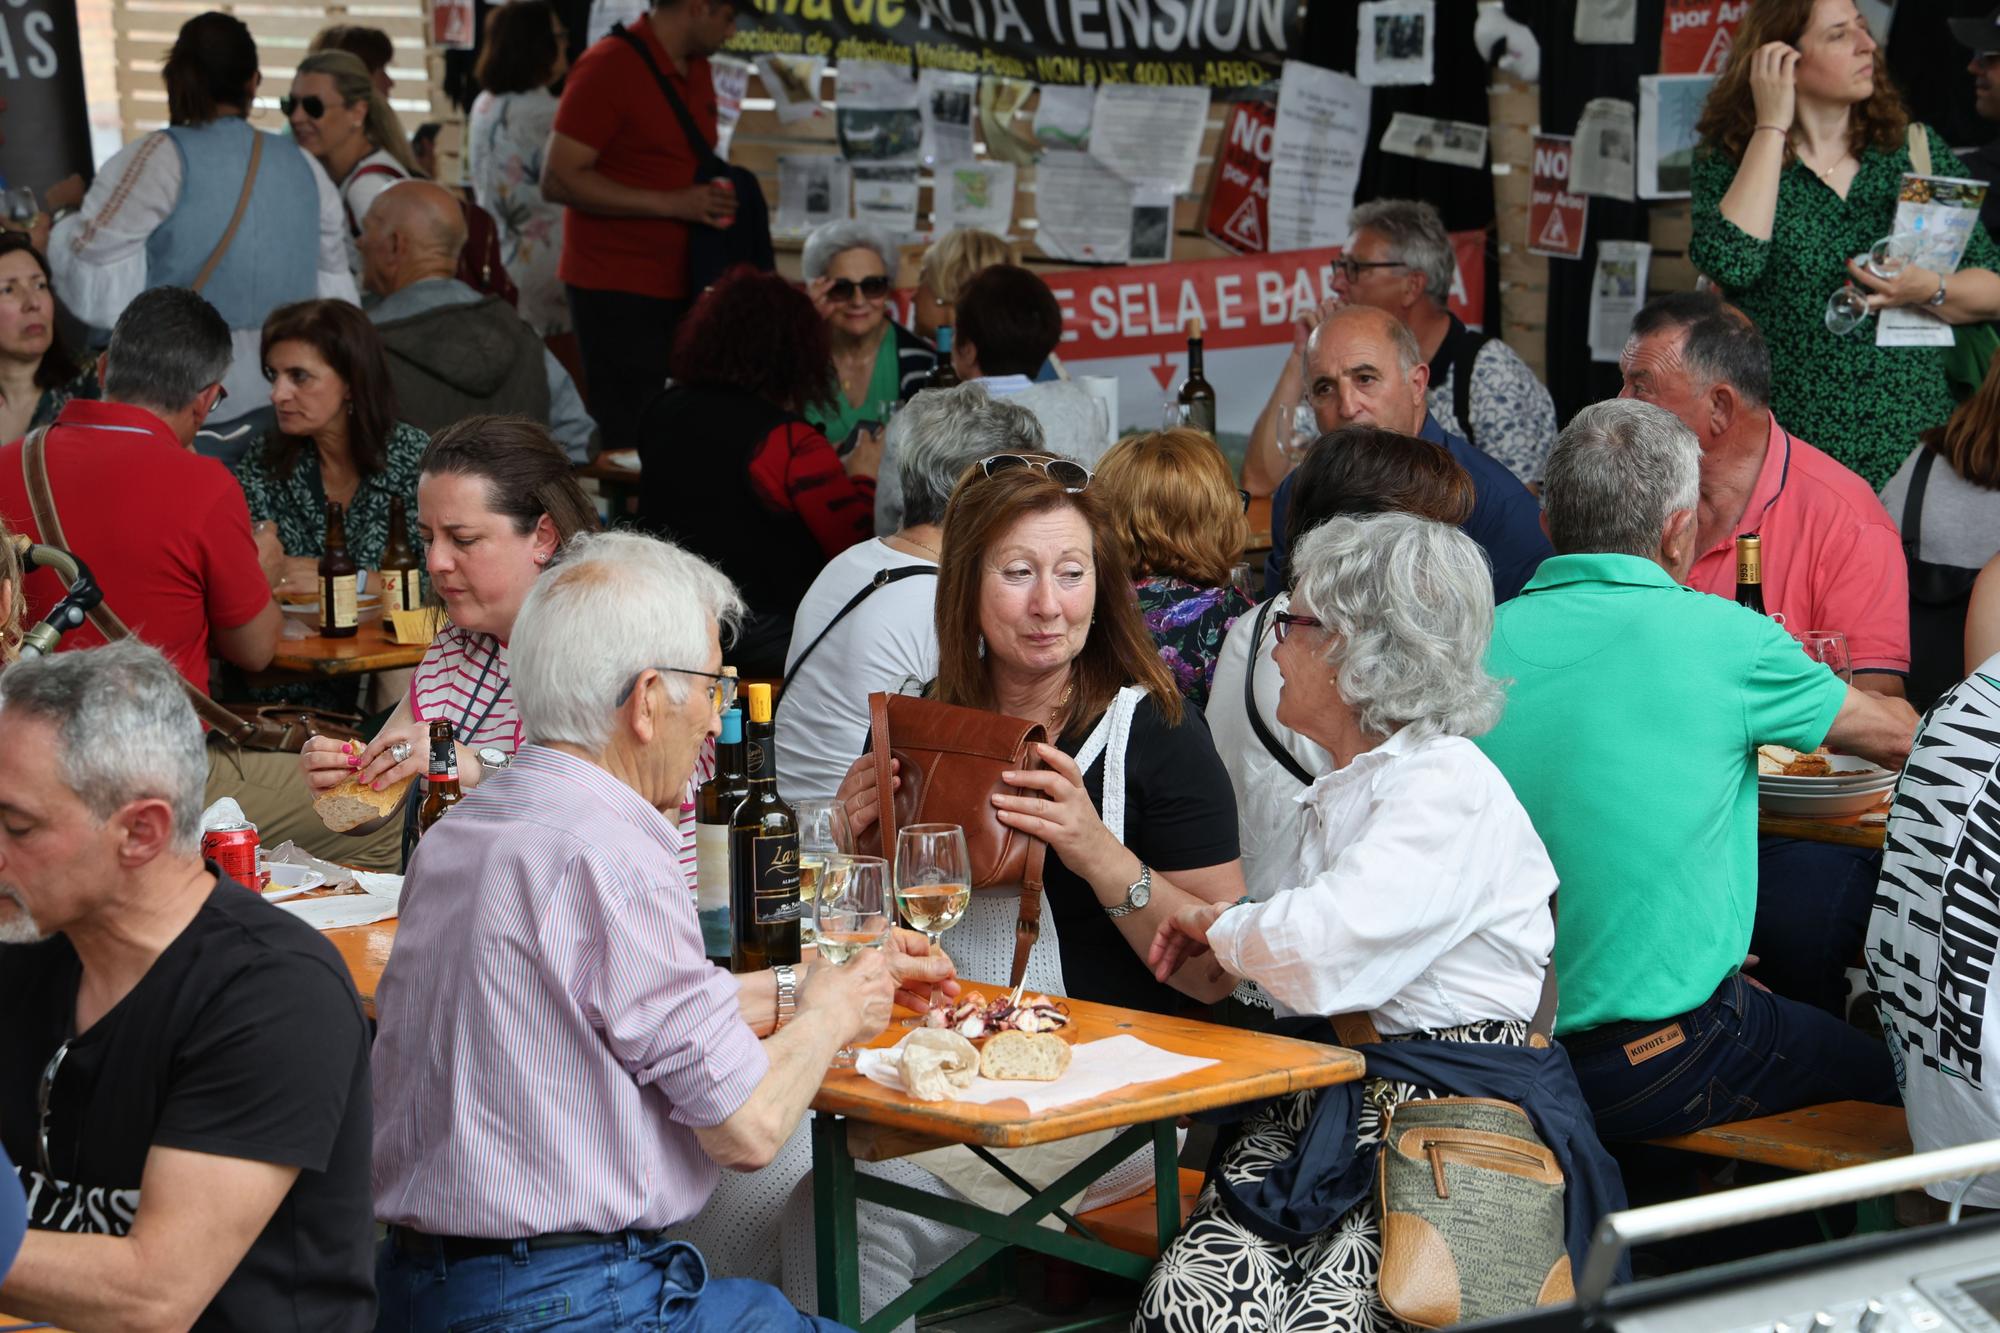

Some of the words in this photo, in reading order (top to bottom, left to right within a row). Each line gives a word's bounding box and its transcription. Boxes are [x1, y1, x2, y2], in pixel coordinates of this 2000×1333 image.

[1671, 9, 1711, 34] por
[1036, 56, 1080, 82] NON
[1134, 62, 1168, 86] 400
[1230, 109, 1274, 163] NO
[1534, 147, 1569, 180] NO
[1089, 279, 1208, 340] SELA
[1215, 274, 1246, 330] E
